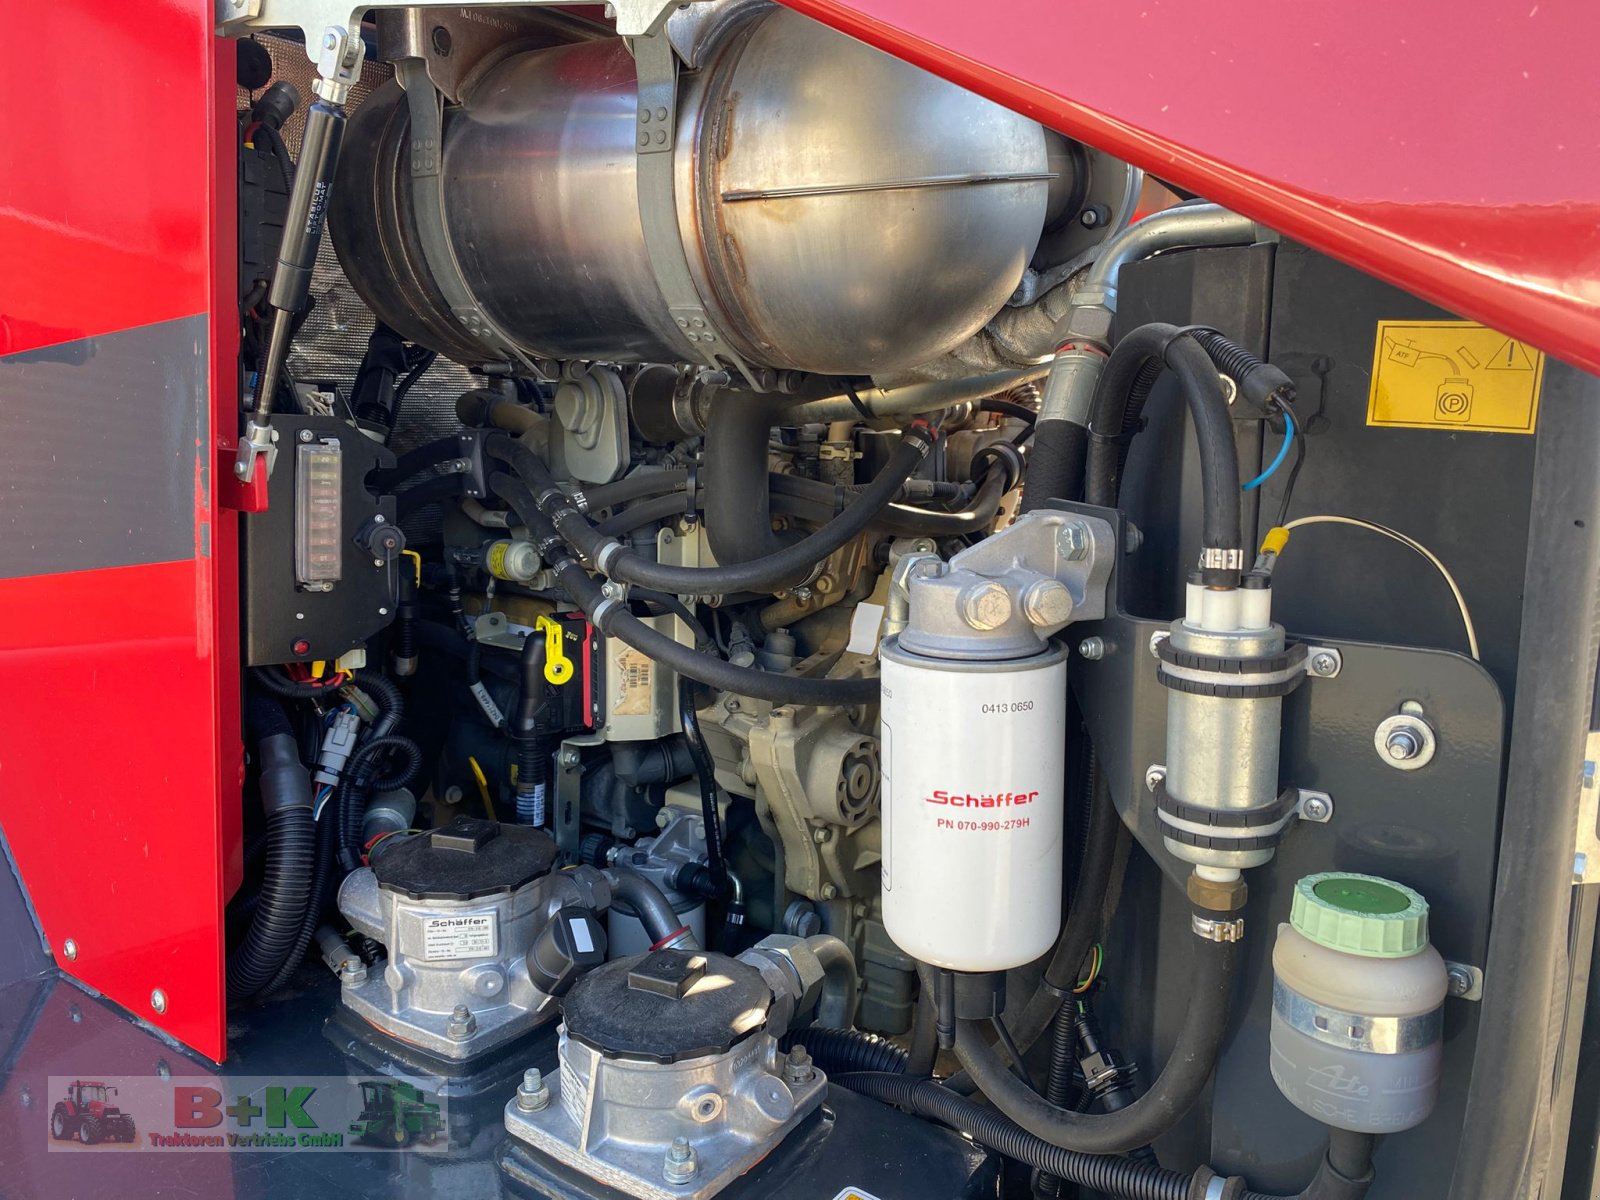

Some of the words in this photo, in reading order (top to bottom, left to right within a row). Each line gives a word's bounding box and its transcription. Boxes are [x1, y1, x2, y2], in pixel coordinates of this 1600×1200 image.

[306, 182, 322, 233] STABILUS
[1396, 351, 1410, 359] ATF
[981, 702, 1009, 714] 0413
[1010, 700, 1034, 713] 0650
[926, 790, 1039, 808] Schäffer
[937, 818, 954, 830] PN
[957, 817, 1030, 831] 070-990-279H
[428, 918, 488, 928] Schäffer
